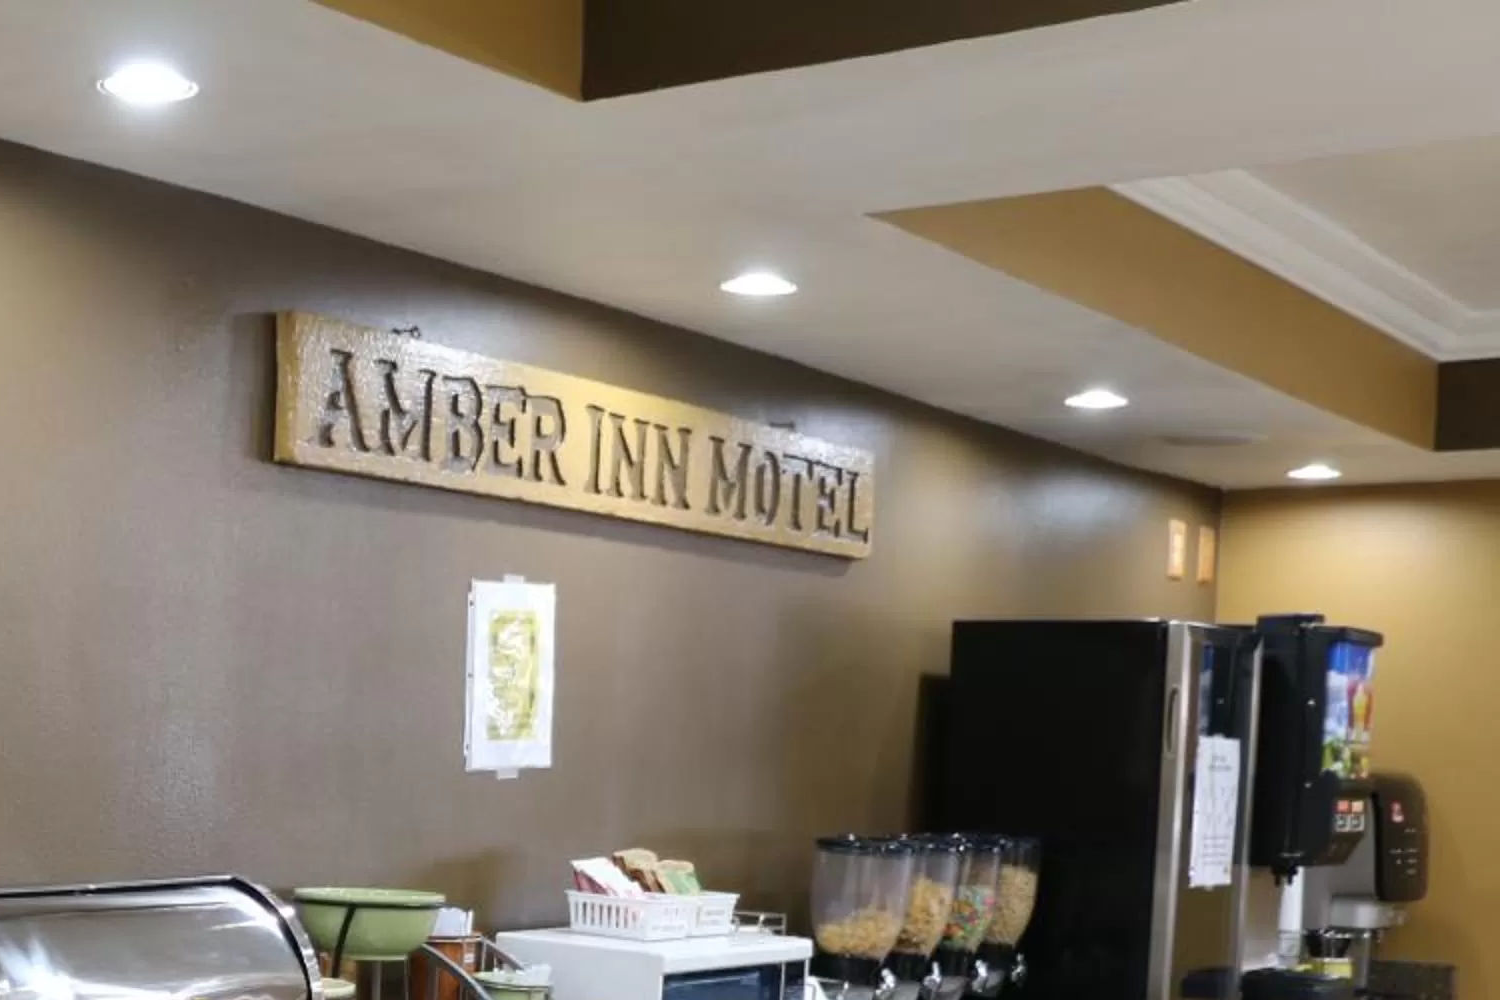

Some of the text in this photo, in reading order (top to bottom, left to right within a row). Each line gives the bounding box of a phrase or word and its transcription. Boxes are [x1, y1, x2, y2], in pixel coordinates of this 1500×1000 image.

[315, 347, 871, 545] AMBER INN MOTEL
